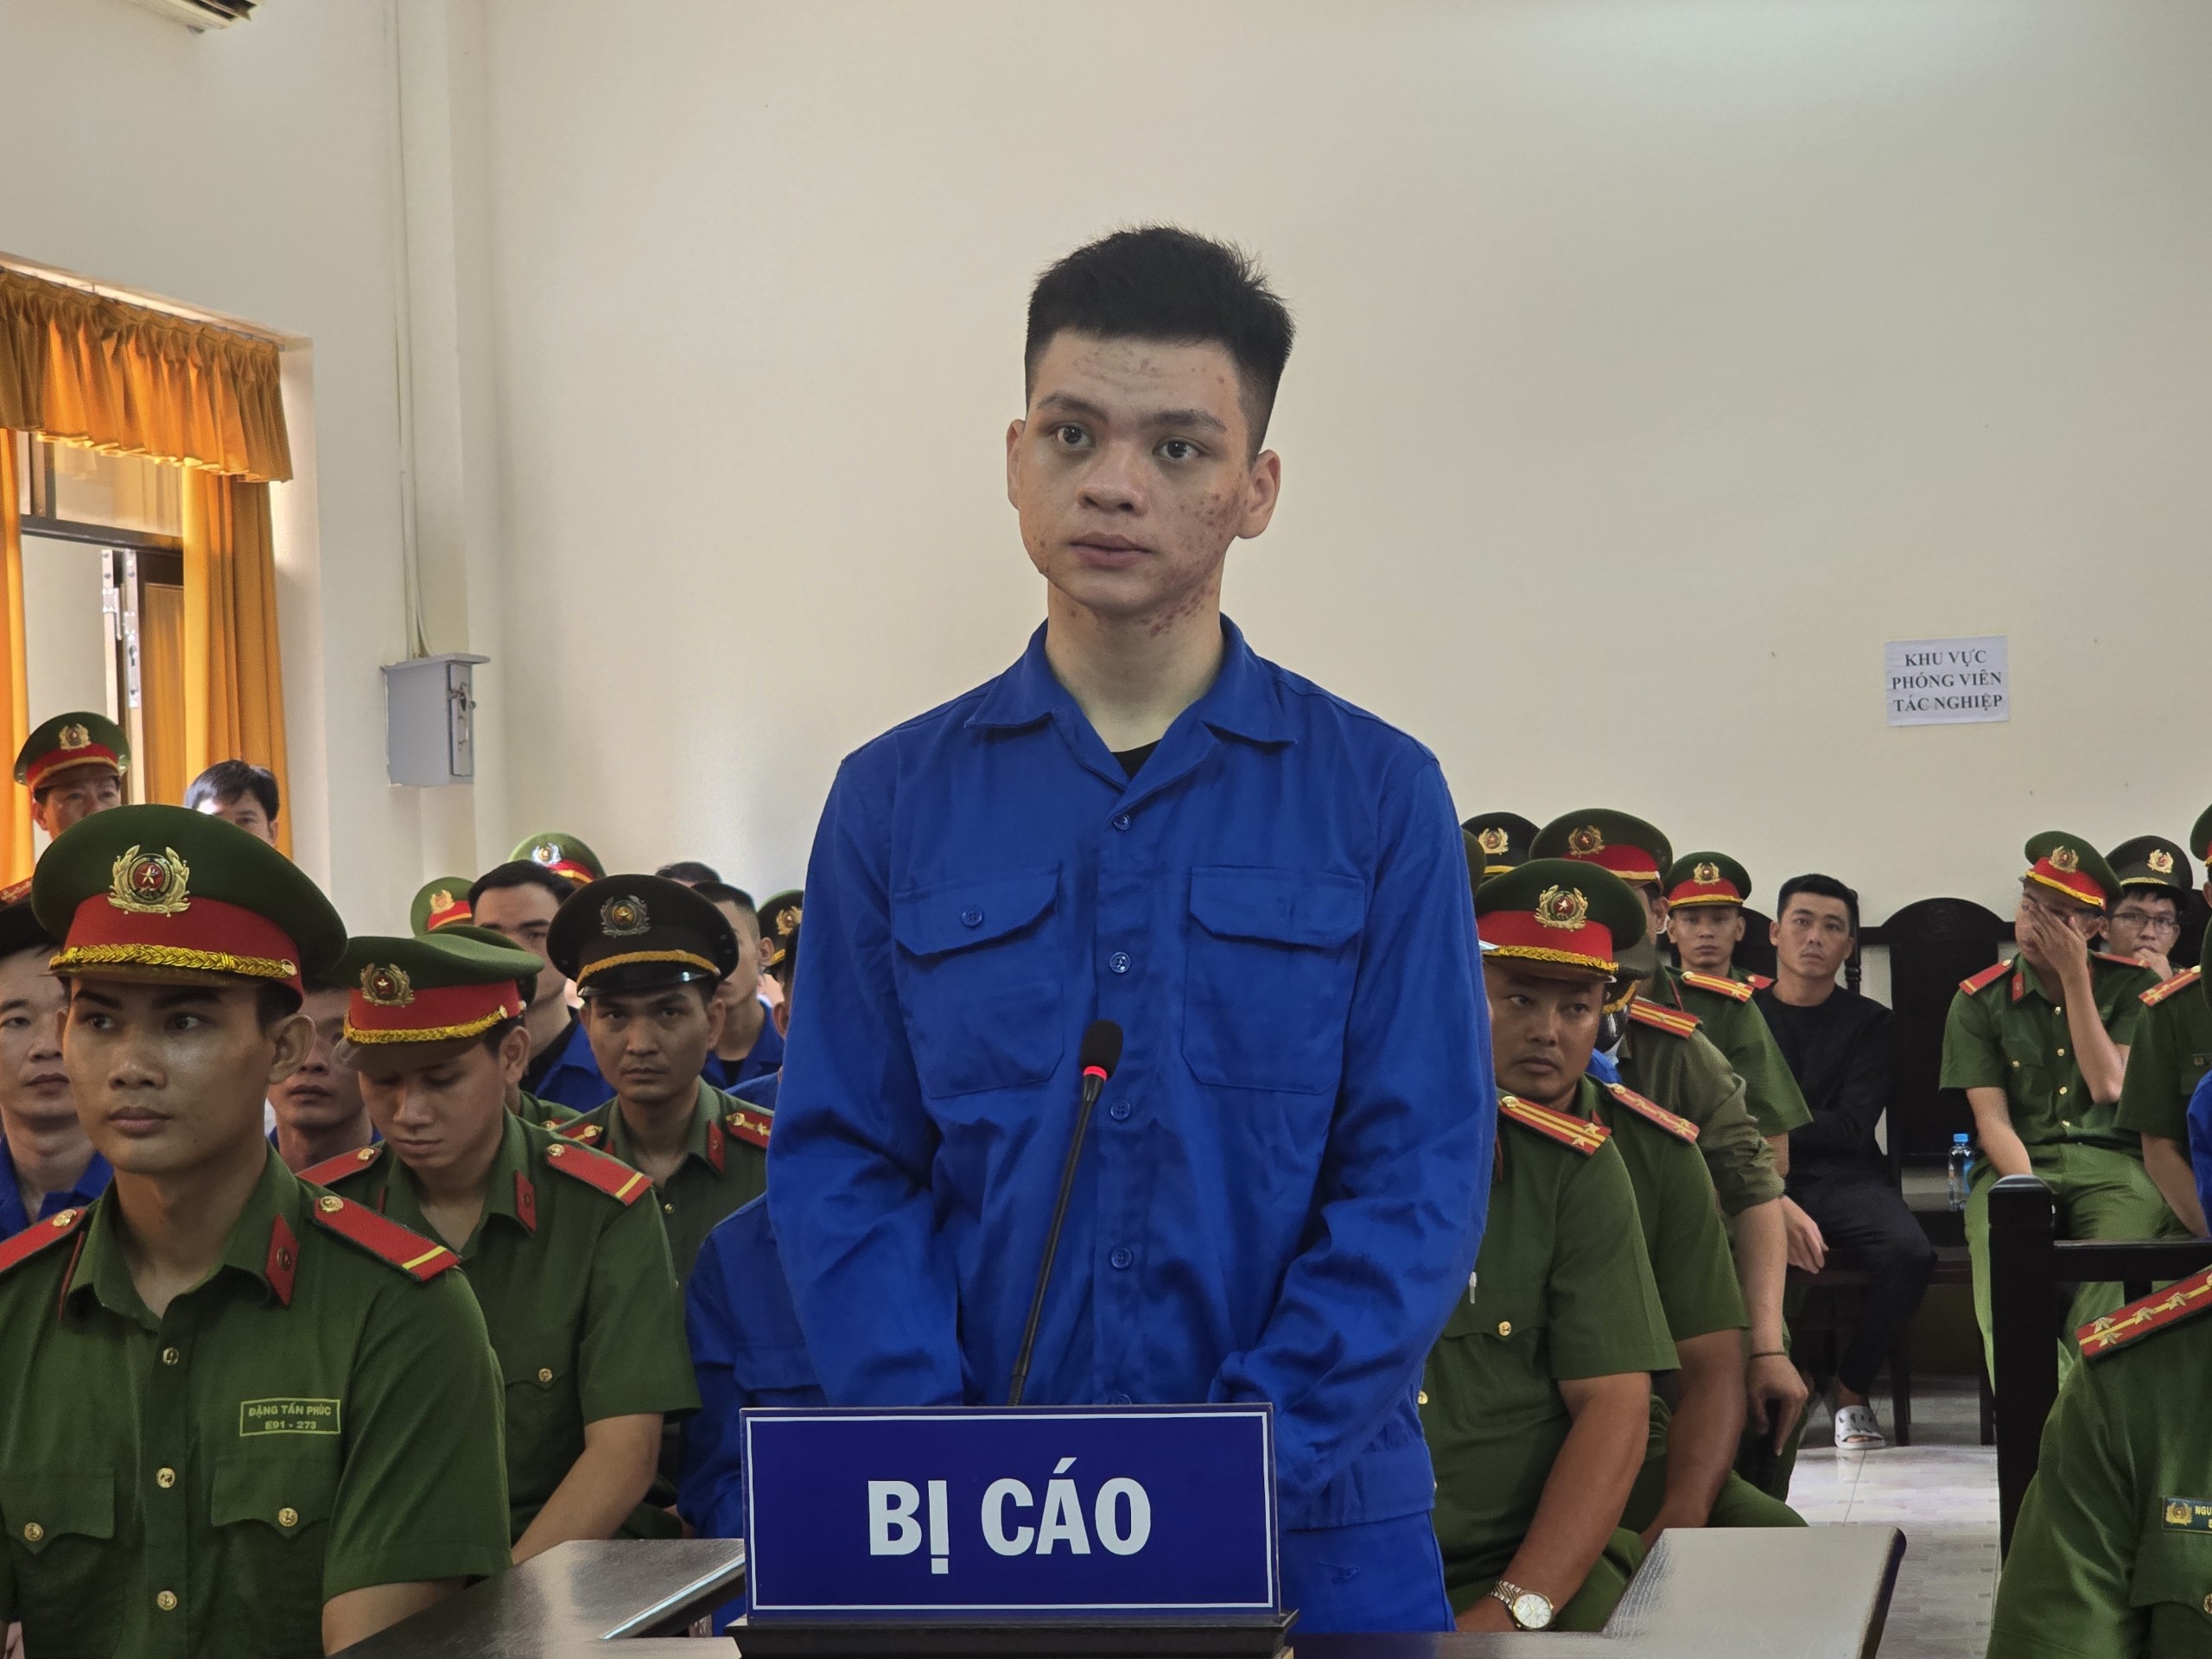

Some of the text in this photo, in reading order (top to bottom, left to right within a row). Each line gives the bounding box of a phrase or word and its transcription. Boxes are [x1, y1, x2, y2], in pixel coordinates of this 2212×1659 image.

[1904, 648, 1987, 667] KHU VỰC
[1891, 669, 2002, 690] PHÓNG VIÊN
[1894, 692, 2002, 712] TÁC NGHIỆP
[306, 1403, 332, 1416] PHÚC
[296, 1421, 317, 1430] 273
[868, 1457, 1152, 1574] BỊ CÁO
